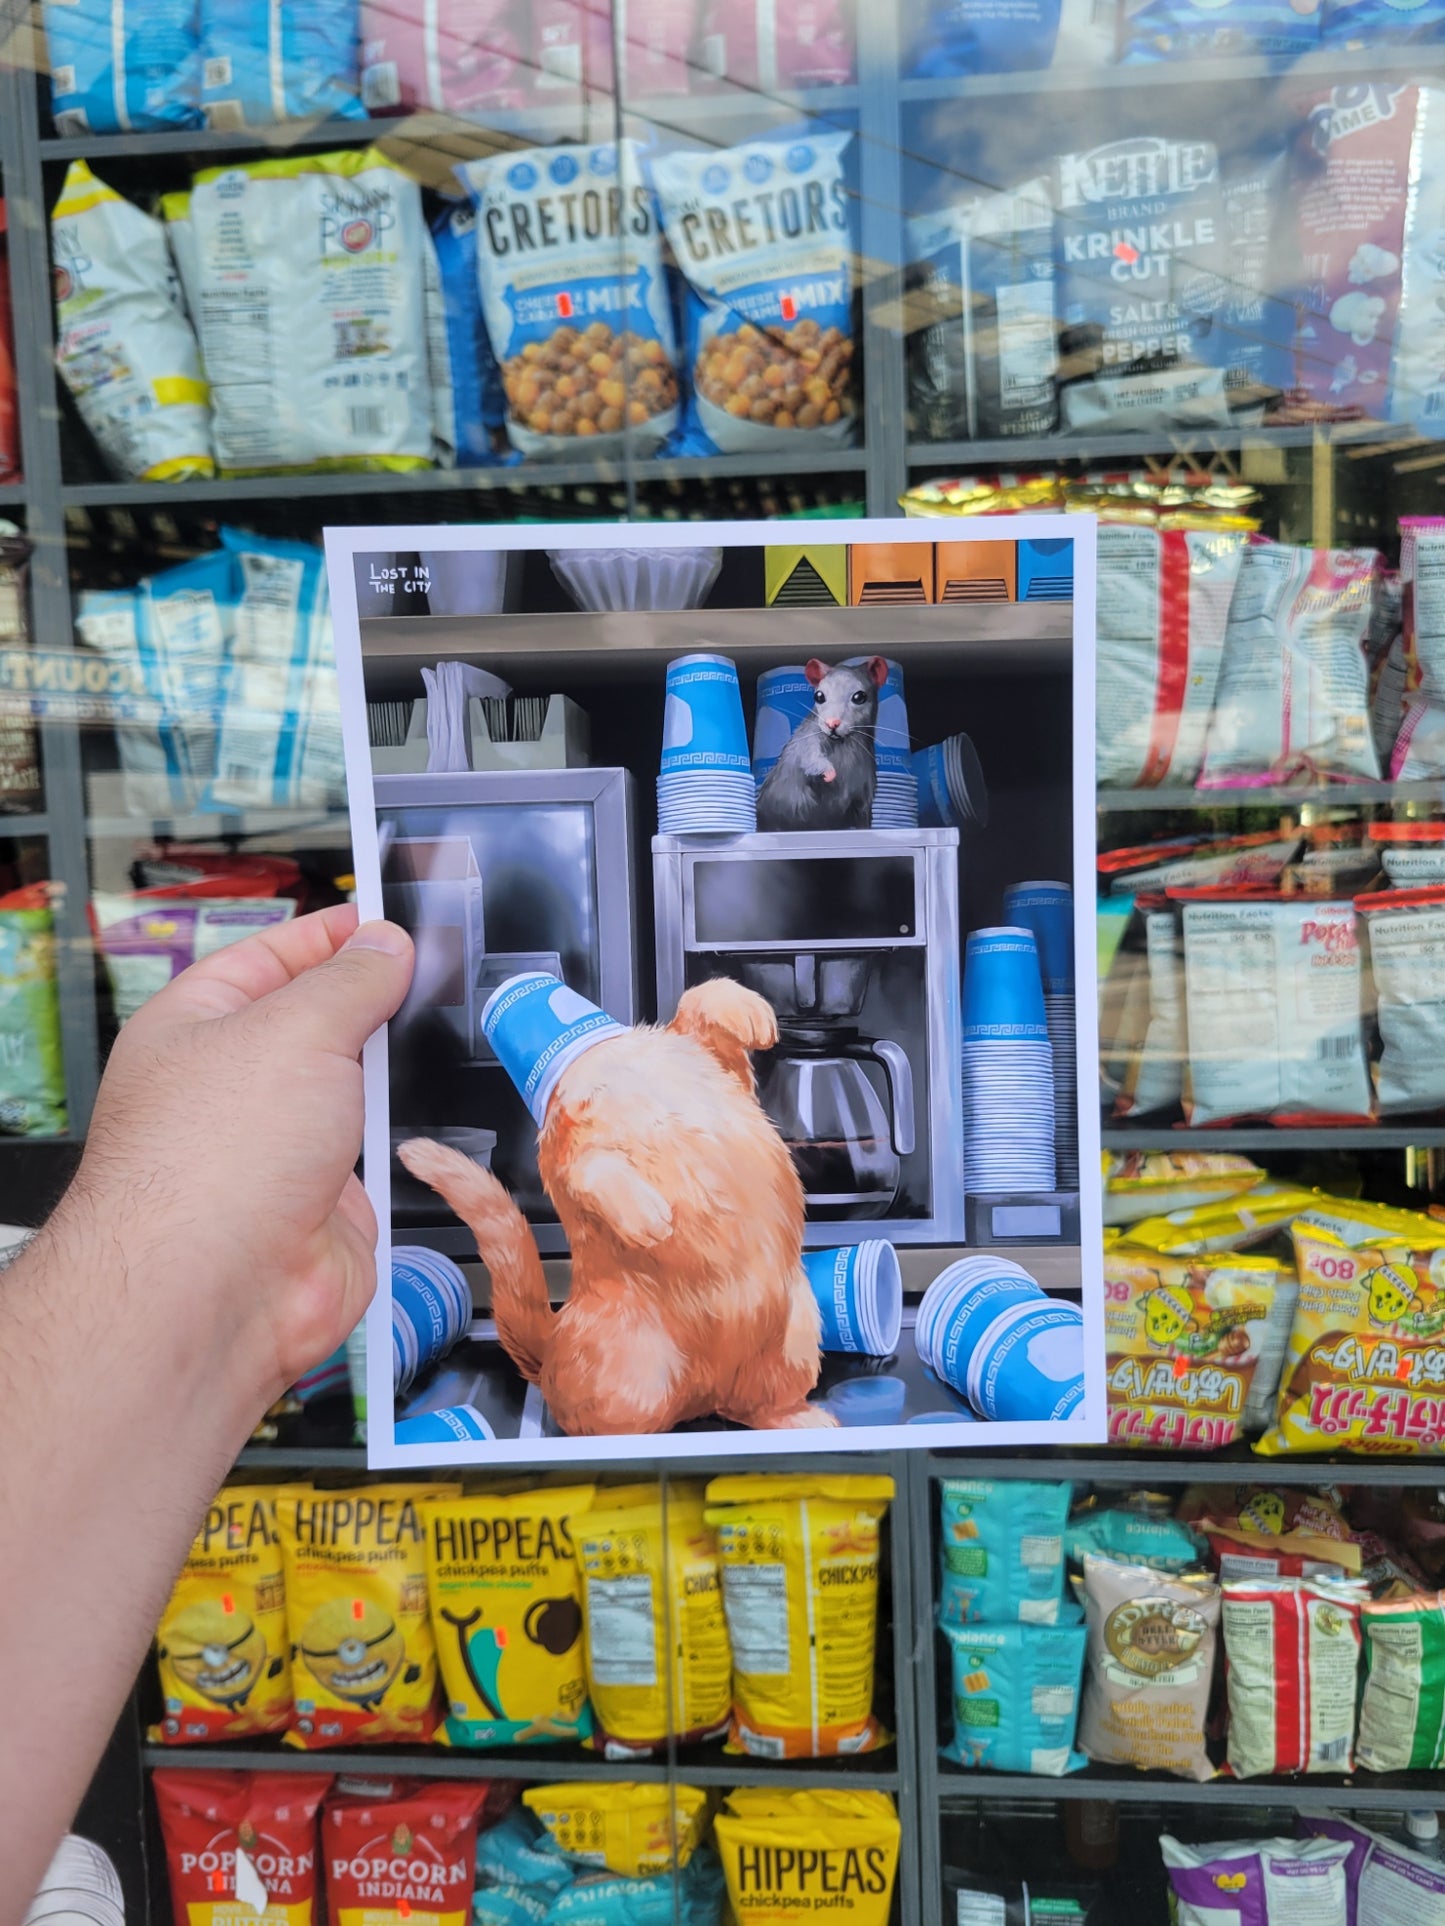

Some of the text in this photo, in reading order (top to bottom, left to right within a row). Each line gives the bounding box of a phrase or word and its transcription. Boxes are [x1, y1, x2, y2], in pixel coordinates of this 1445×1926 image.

[1058, 142, 1218, 209] KETTLE
[485, 186, 650, 258] CRETORS
[681, 178, 848, 261] CRETORS
[1107, 201, 1168, 221] BRAND
[1063, 218, 1216, 262] KRINKLE
[1110, 253, 1170, 283] CUT
[1110, 301, 1165, 326] SALT
[1102, 334, 1193, 364] PEPPER
[369, 563, 430, 580] LOST IN
[368, 581, 431, 594] THE CITY
[296, 1498, 426, 1546] HIPPEA
[435, 1515, 576, 1561] HIPPEAS
[180, 1850, 315, 1877] POPORN
[332, 1856, 468, 1886] POPCORN
[738, 1845, 888, 1894] HIPPEAS
[358, 1881, 445, 1903] INDIANA
[740, 1893, 855, 1910] chickpea puffs
